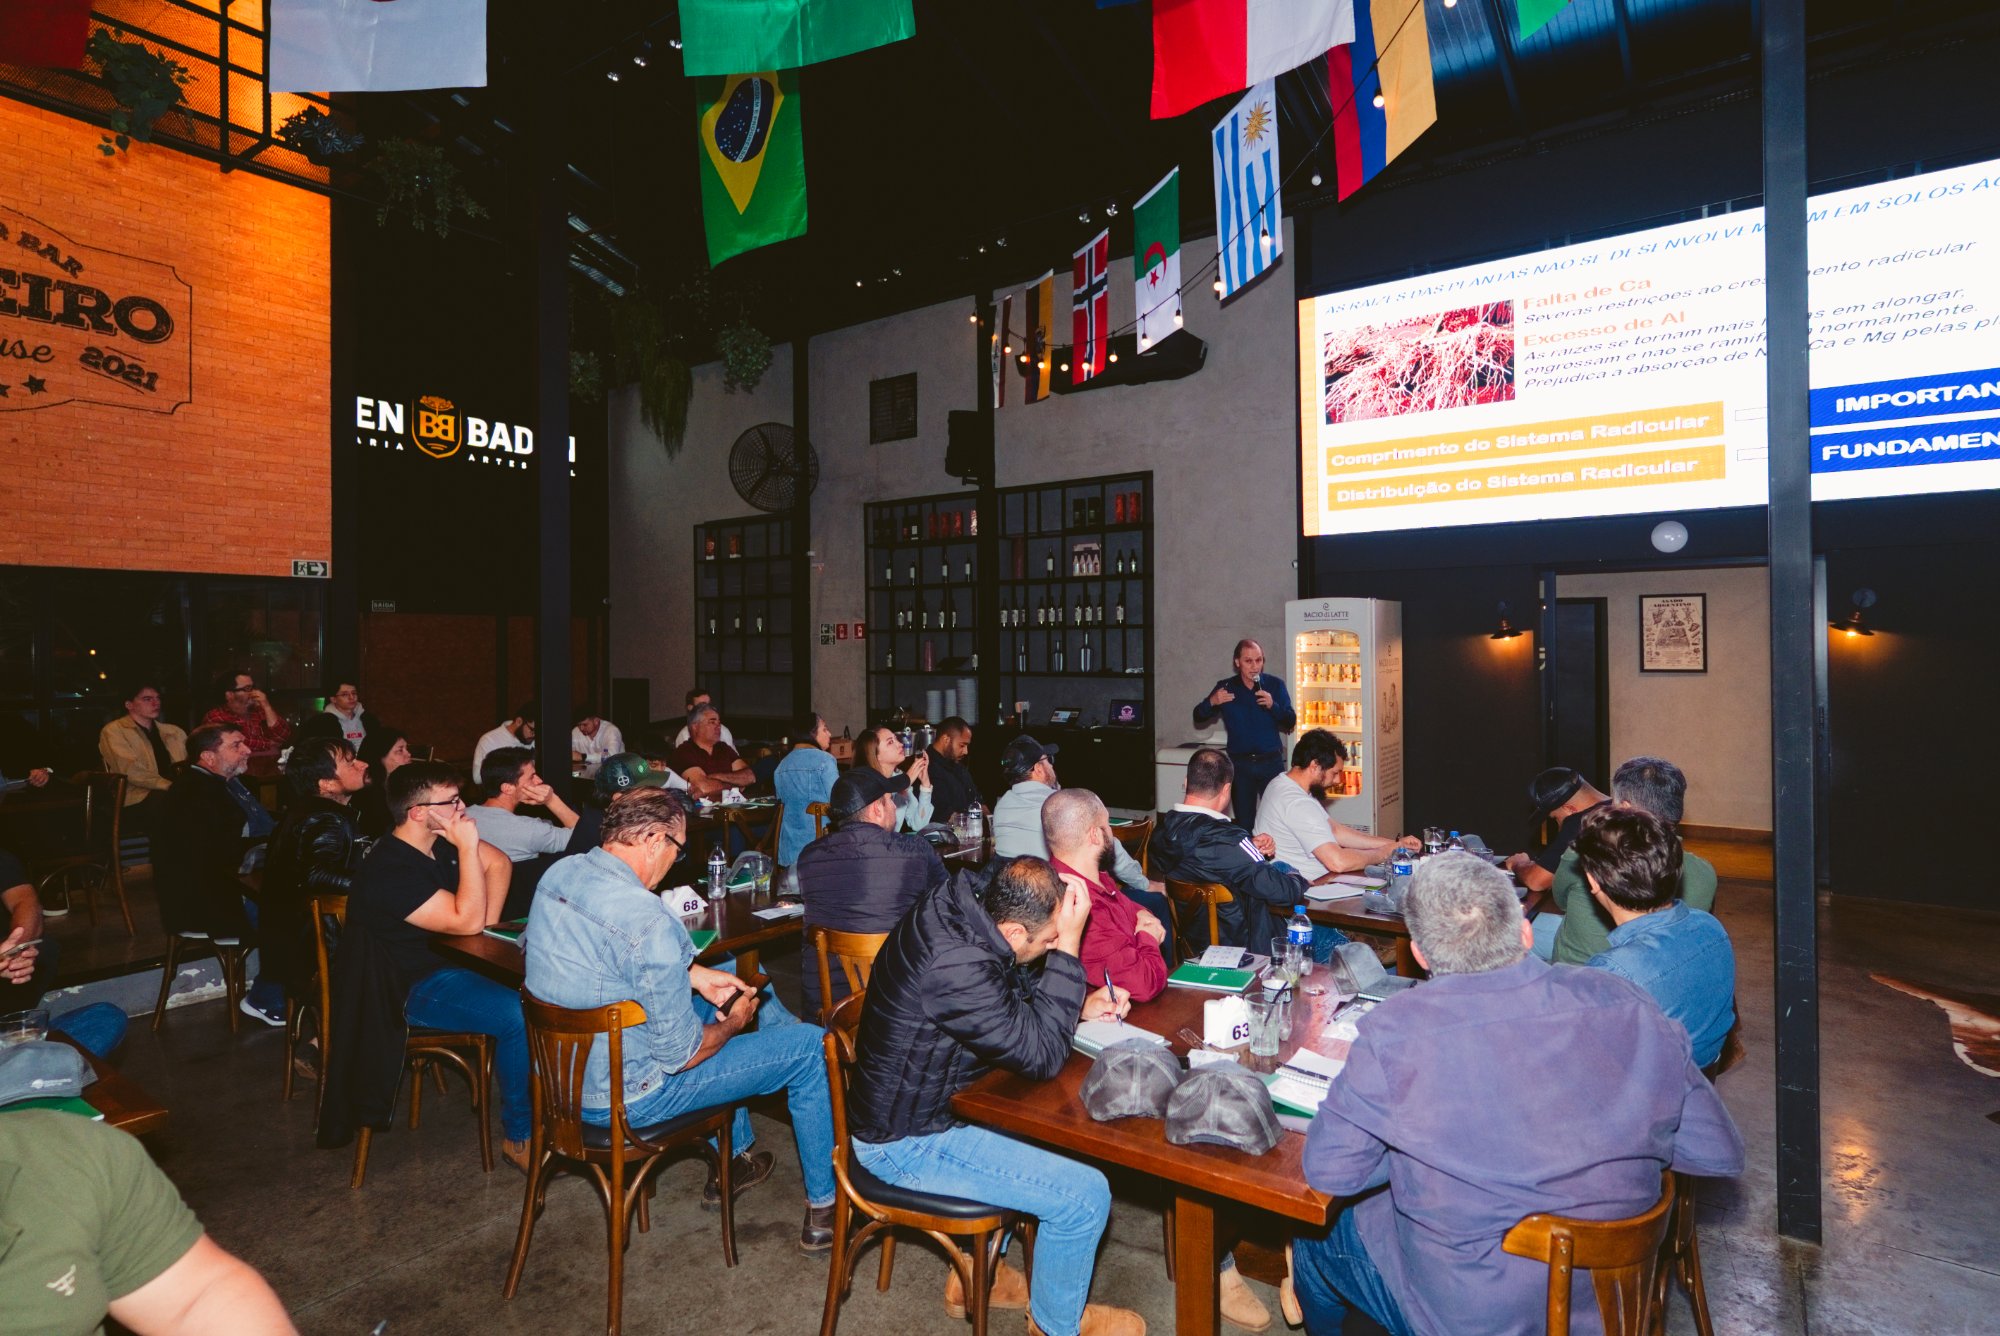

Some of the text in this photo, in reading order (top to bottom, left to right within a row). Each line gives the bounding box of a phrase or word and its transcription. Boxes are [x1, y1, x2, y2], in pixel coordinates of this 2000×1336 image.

[1876, 182, 1966, 210] SOLOS
[17, 230, 84, 279] BAR
[1523, 279, 1651, 310] Falta de Ca
[1524, 304, 1592, 323] Severas
[1698, 284, 1722, 296] ao
[1868, 240, 1977, 268] radicular
[1523, 324, 1617, 347] Excesso
[1624, 318, 1653, 331] de
[1608, 340, 1628, 349] se
[1635, 329, 1702, 345] tornam
[1708, 320, 1754, 334] mais
[1832, 304, 1866, 316] em
[79, 346, 159, 392] 2021
[1525, 372, 1606, 388] Prejudica
[1724, 351, 1748, 361] de
[1843, 337, 1856, 346] e
[1863, 331, 1896, 344] Mg
[1902, 321, 1968, 340] pelas
[1525, 355, 1620, 374] engrossam
[1626, 353, 1636, 361] e
[1682, 343, 1704, 353] se
[1836, 381, 2000, 413] IMPORTAN
[1331, 415, 1710, 467] Comprimento do Sistema Radicular
[1822, 431, 2000, 461] FUNDAMEN
[1337, 459, 1700, 503] Distribuição do Sistema Radicular
[683, 900, 698, 912] 68
[1232, 1022, 1249, 1040] 63
